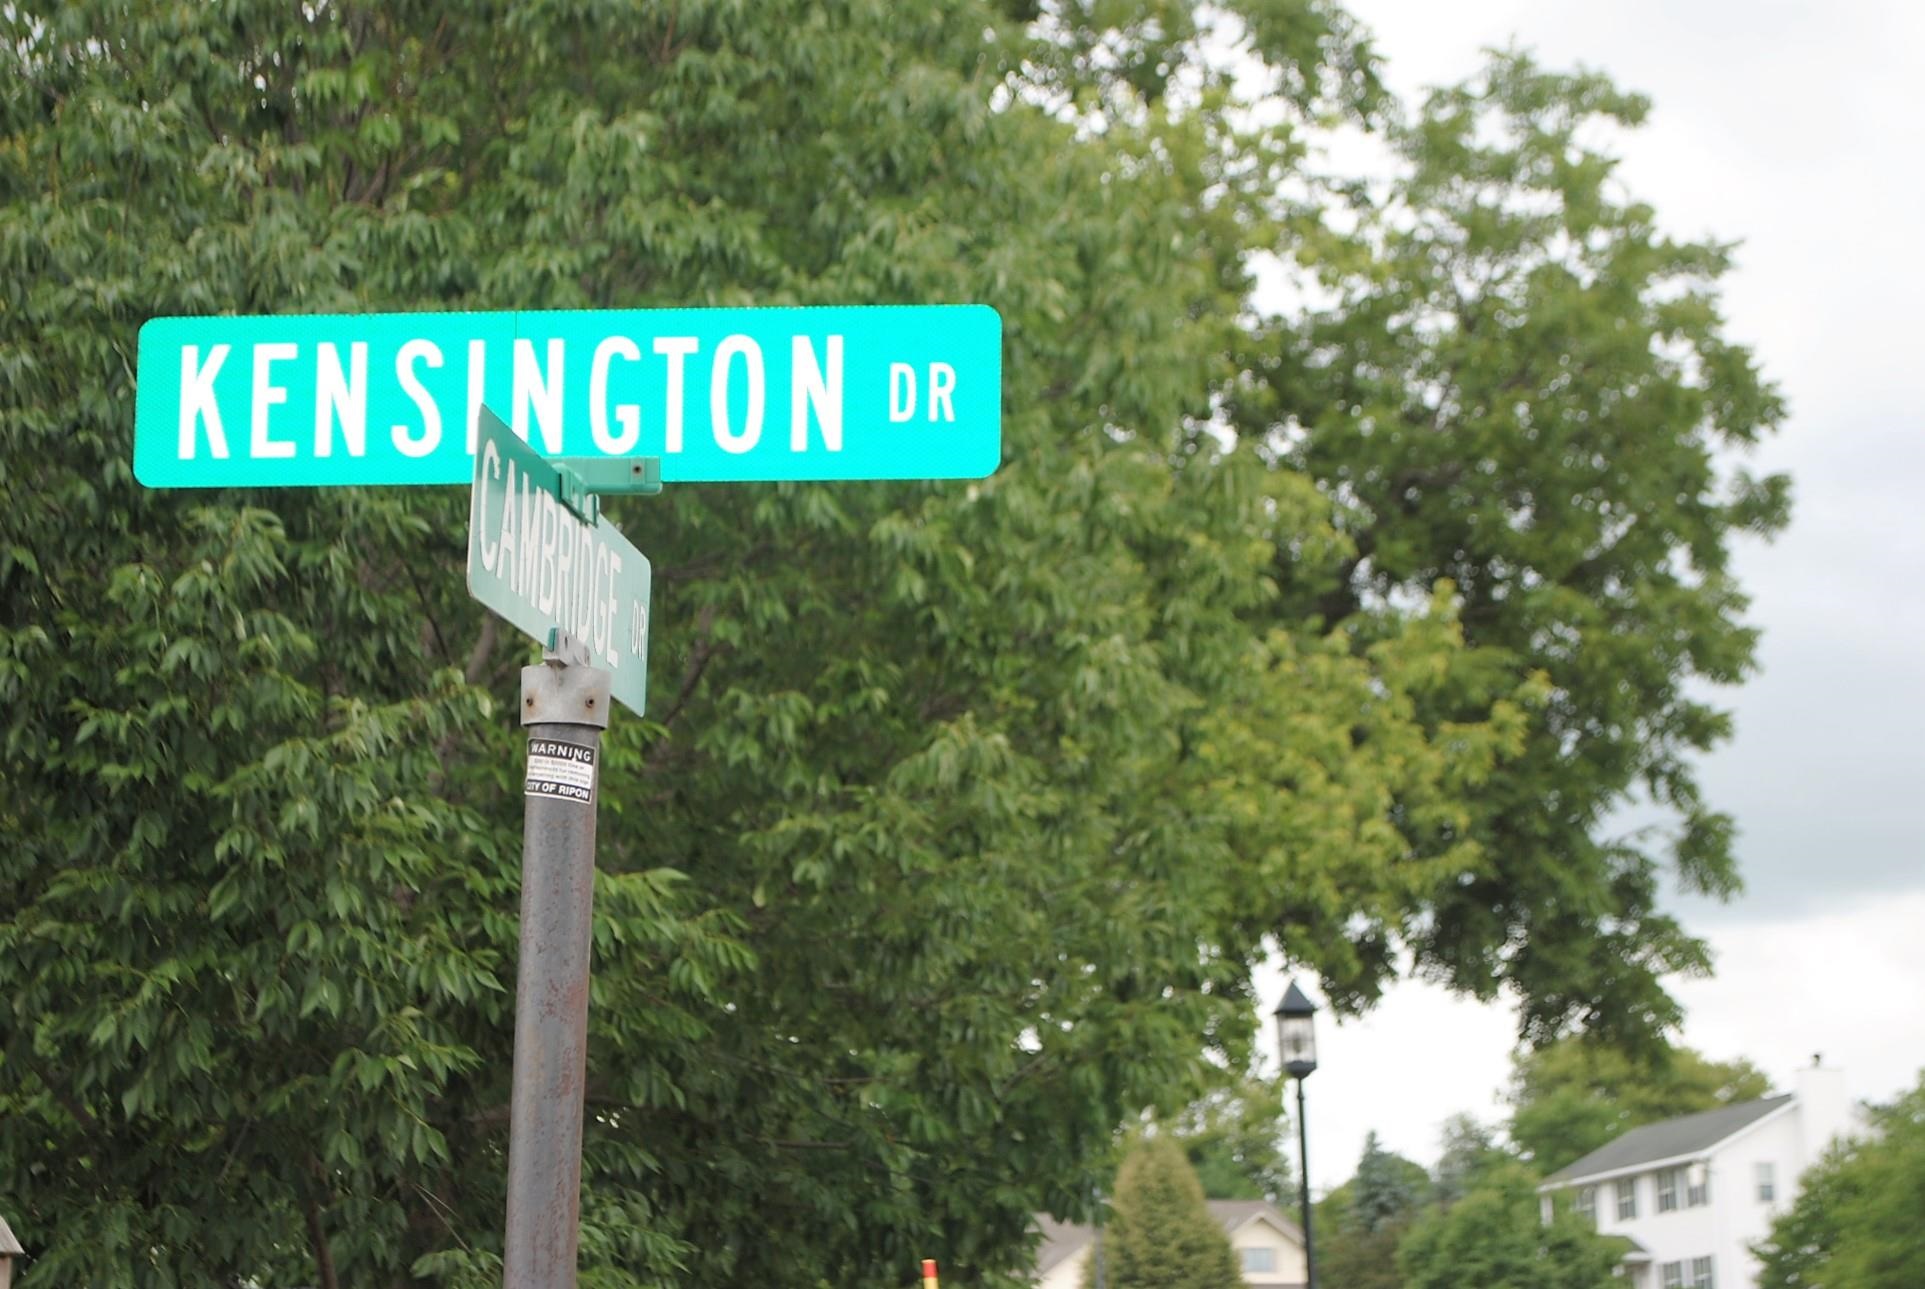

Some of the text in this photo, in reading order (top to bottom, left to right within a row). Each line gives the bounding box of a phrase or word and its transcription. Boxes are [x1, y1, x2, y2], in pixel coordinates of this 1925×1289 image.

[177, 334, 957, 461] KENSINGTON DR
[479, 438, 648, 669] CAMBRIDGE DR
[531, 742, 592, 762] WARNING
[541, 782, 557, 793] OF
[558, 784, 590, 800] RIPON
